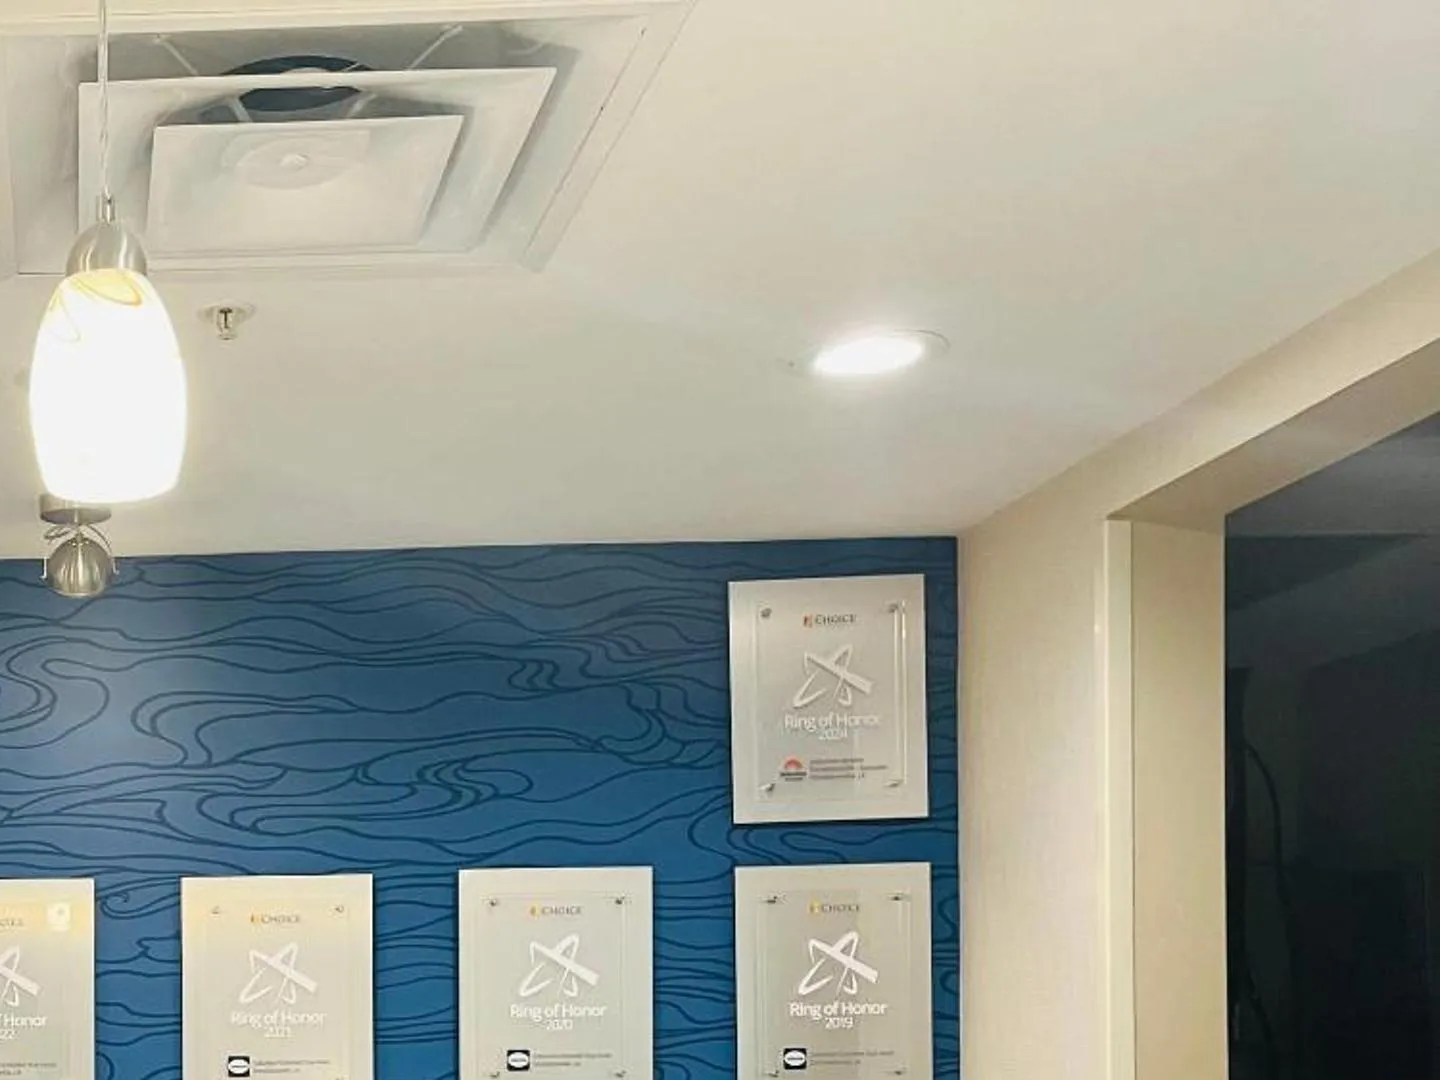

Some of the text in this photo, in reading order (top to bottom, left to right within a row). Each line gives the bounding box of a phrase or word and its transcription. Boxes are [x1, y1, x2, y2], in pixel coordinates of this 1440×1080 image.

[784, 712, 880, 732] Ring of Honor
[231, 1010, 327, 1029] Ring of Honor
[510, 1003, 608, 1022] Ring of Honor
[789, 1000, 888, 1020] Ring of Honor
[4, 1013, 47, 1028] Honor
[824, 1016, 854, 1030] 2019
